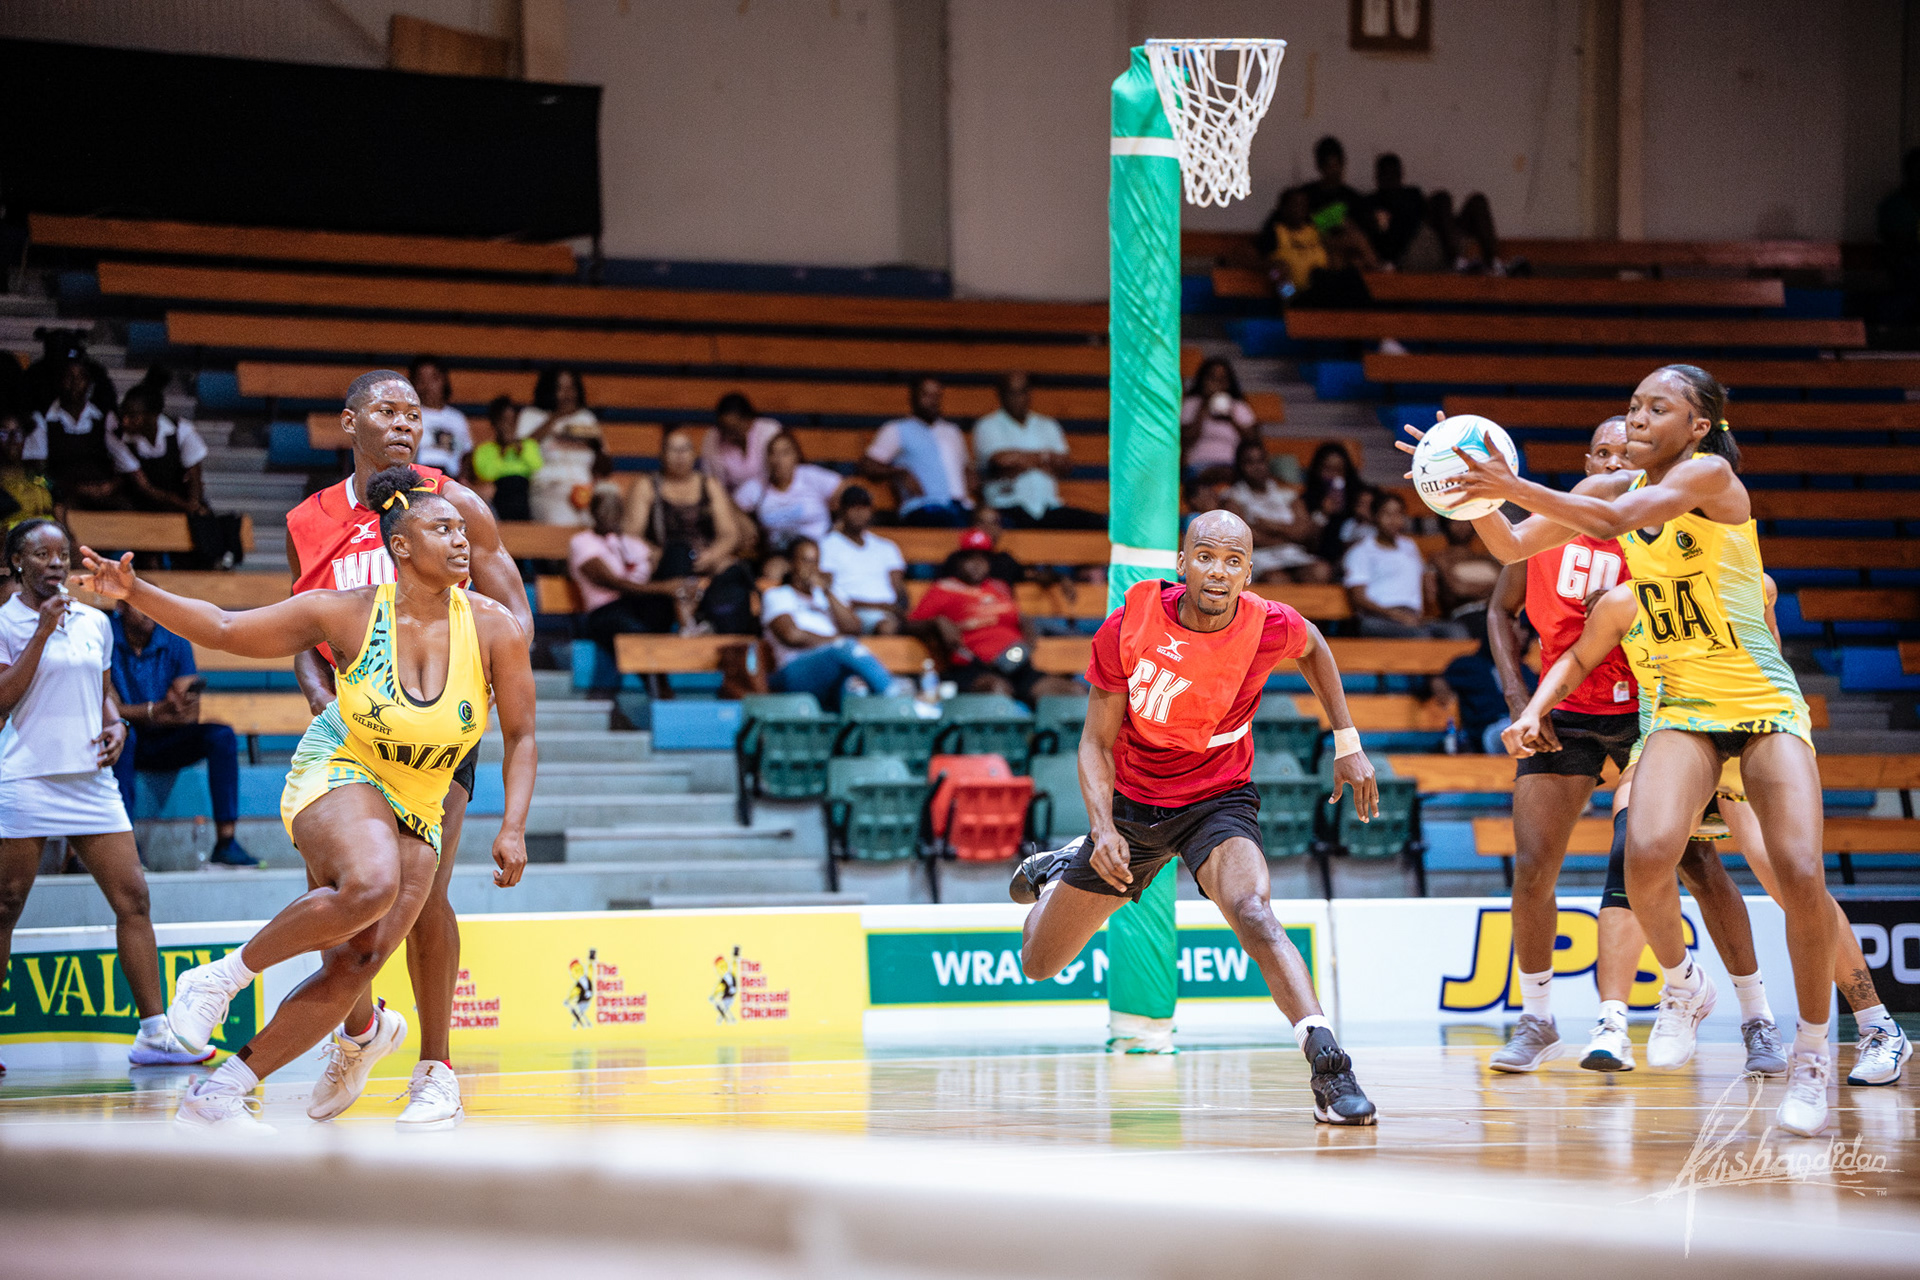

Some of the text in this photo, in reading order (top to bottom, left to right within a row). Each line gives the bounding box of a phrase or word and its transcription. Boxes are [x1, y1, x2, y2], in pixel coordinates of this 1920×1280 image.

[1556, 543, 1622, 600] GD
[1635, 578, 1718, 644] GA
[1156, 647, 1182, 662] GILBERT
[1127, 657, 1193, 724] GK
[352, 712, 393, 736] GILBERT
[597, 963, 617, 975] The
[741, 960, 760, 971] The
[931, 950, 1036, 986] WRA
[597, 980, 623, 991] Best
[741, 976, 766, 987] Best
[597, 994, 647, 1006] Dressed
[741, 991, 788, 1002] Dressed
[597, 1011, 646, 1023] Chicken
[741, 1007, 787, 1018] Chicken
